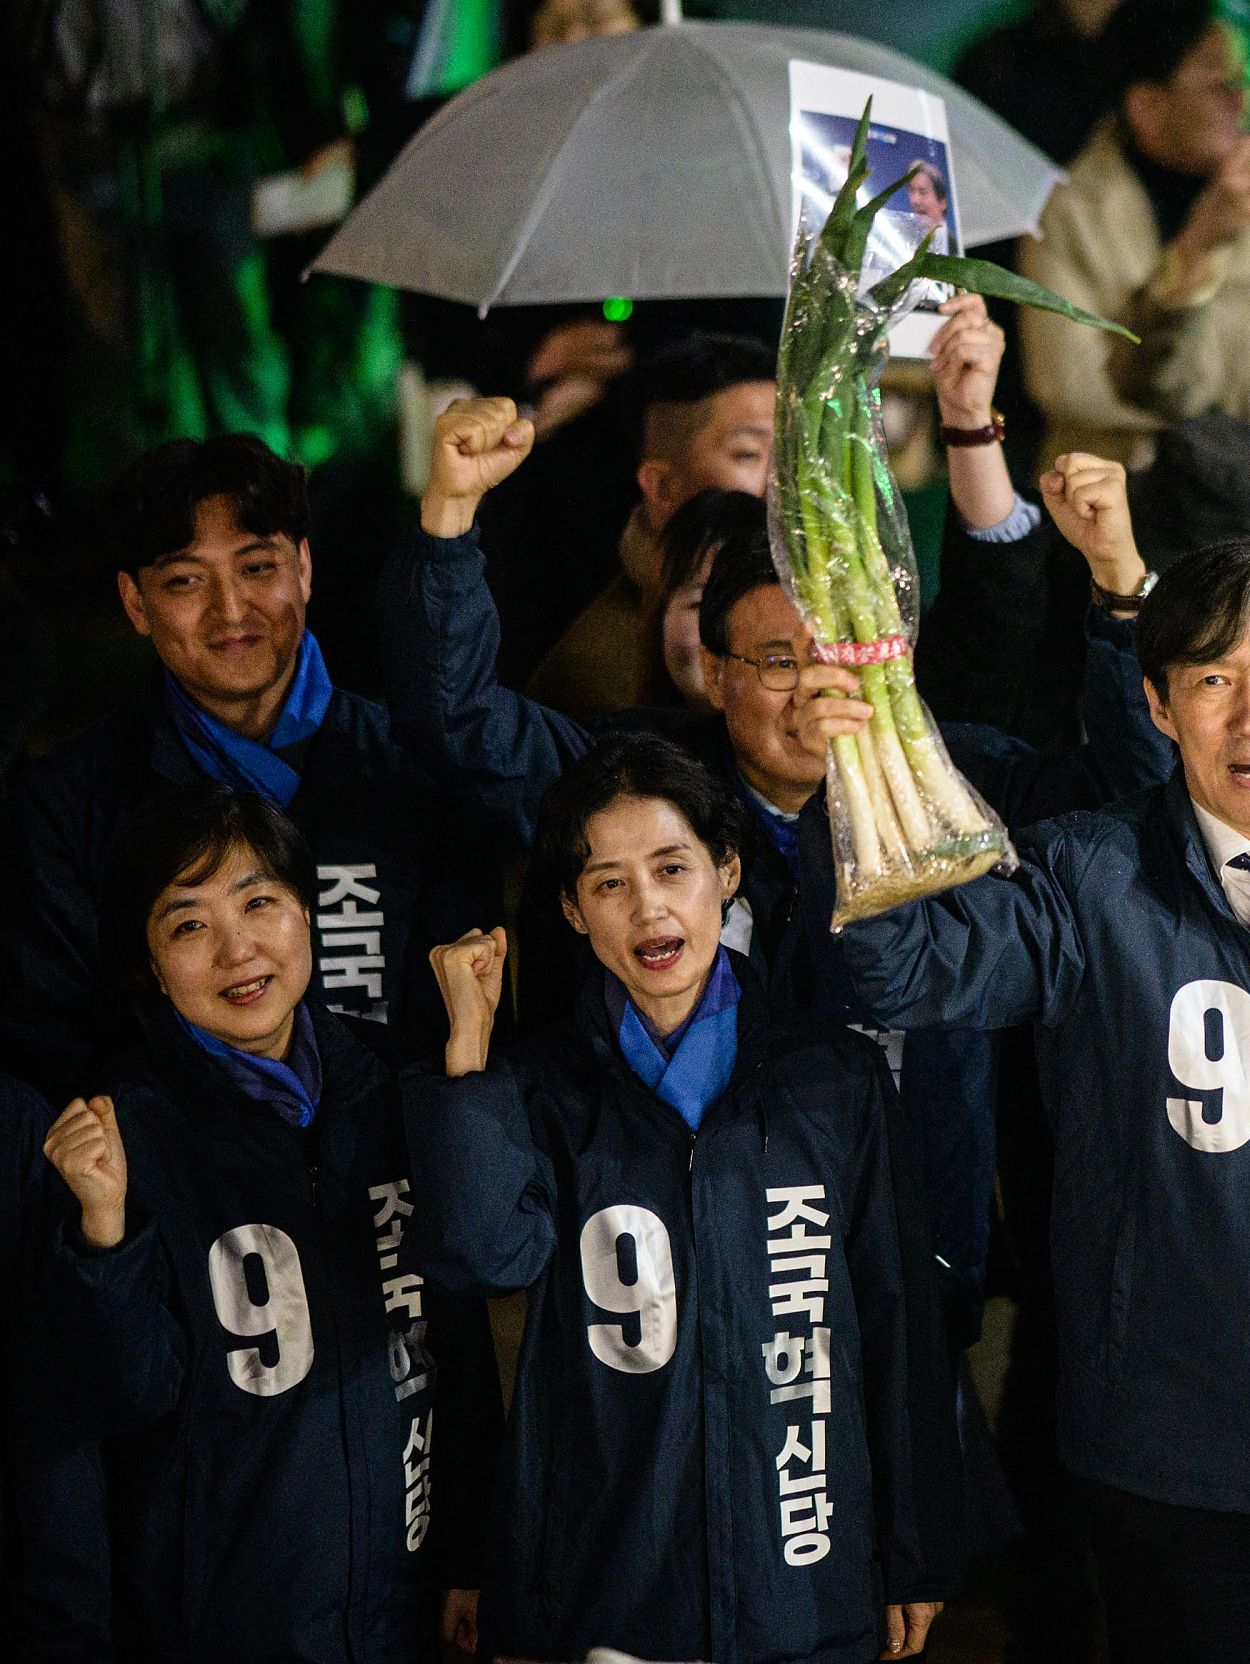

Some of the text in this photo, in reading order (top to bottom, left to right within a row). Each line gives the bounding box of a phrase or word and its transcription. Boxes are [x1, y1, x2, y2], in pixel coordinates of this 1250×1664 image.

[208, 1223, 315, 1397] 9
[580, 1204, 678, 1374] 9
[762, 1184, 834, 1567] 조국혁신당
